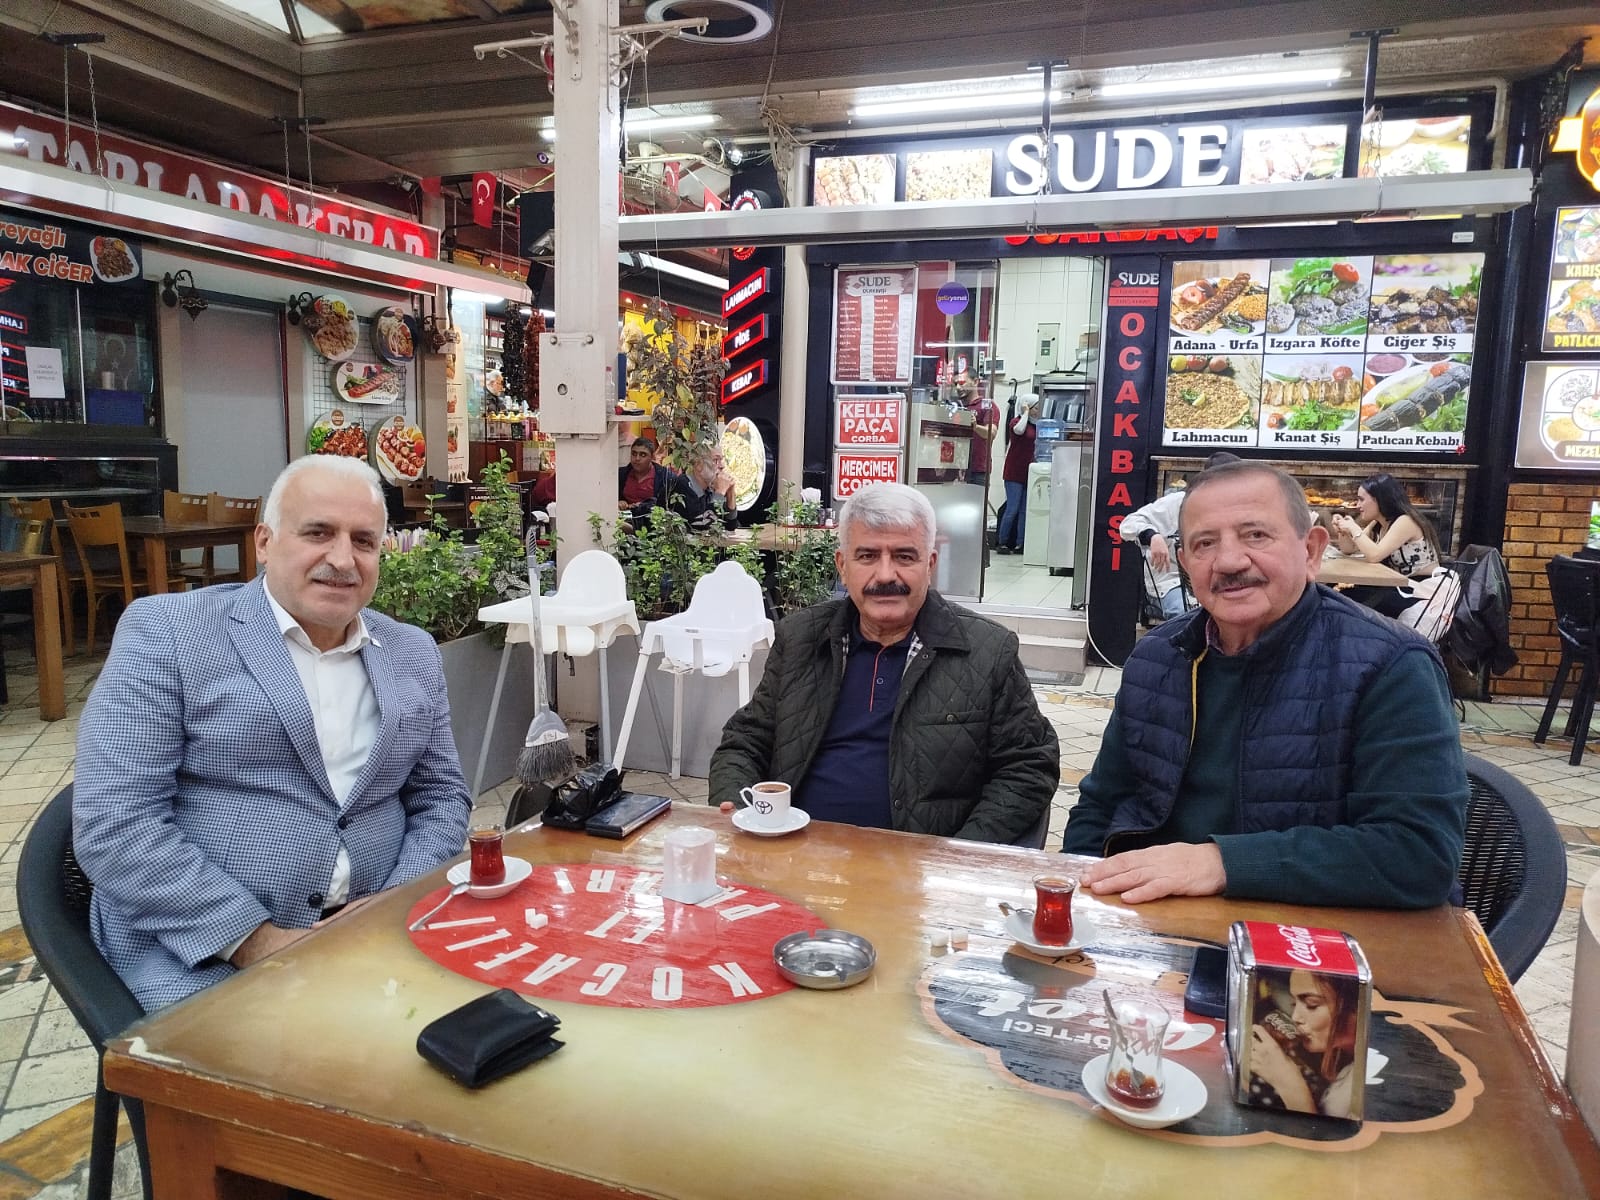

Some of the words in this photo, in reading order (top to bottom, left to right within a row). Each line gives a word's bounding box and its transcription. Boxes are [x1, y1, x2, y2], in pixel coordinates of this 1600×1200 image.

[1005, 125, 1229, 195] SUDE
[0, 251, 33, 274] AK
[33, 253, 94, 284] CİĞER
[859, 276, 891, 287] SUDE
[1118, 272, 1160, 285] SUDE
[725, 276, 763, 312] LAHMACUN
[1174, 340, 1216, 351] Adana
[1229, 339, 1259, 350] Urfa
[1270, 337, 1315, 351] Izgara
[1320, 336, 1361, 348] Köfte
[1383, 335, 1427, 350] Ciğer
[1432, 335, 1456, 350] Şiş
[731, 371, 753, 393] KEBAP
[842, 403, 897, 418] KELLE
[844, 418, 894, 435] PAÇA
[1107, 312, 1146, 571] OCAKBAŞI
[1171, 431, 1248, 443] Lahmacun
[1274, 432, 1316, 442] Kanat
[1320, 432, 1341, 445] Şiş
[1362, 435, 1414, 445] Patlıcan
[1415, 435, 1460, 446] Kebabı
[841, 459, 895, 477] MERCİMEK
[1003, 1017, 1112, 1050] ÖFTECİ
